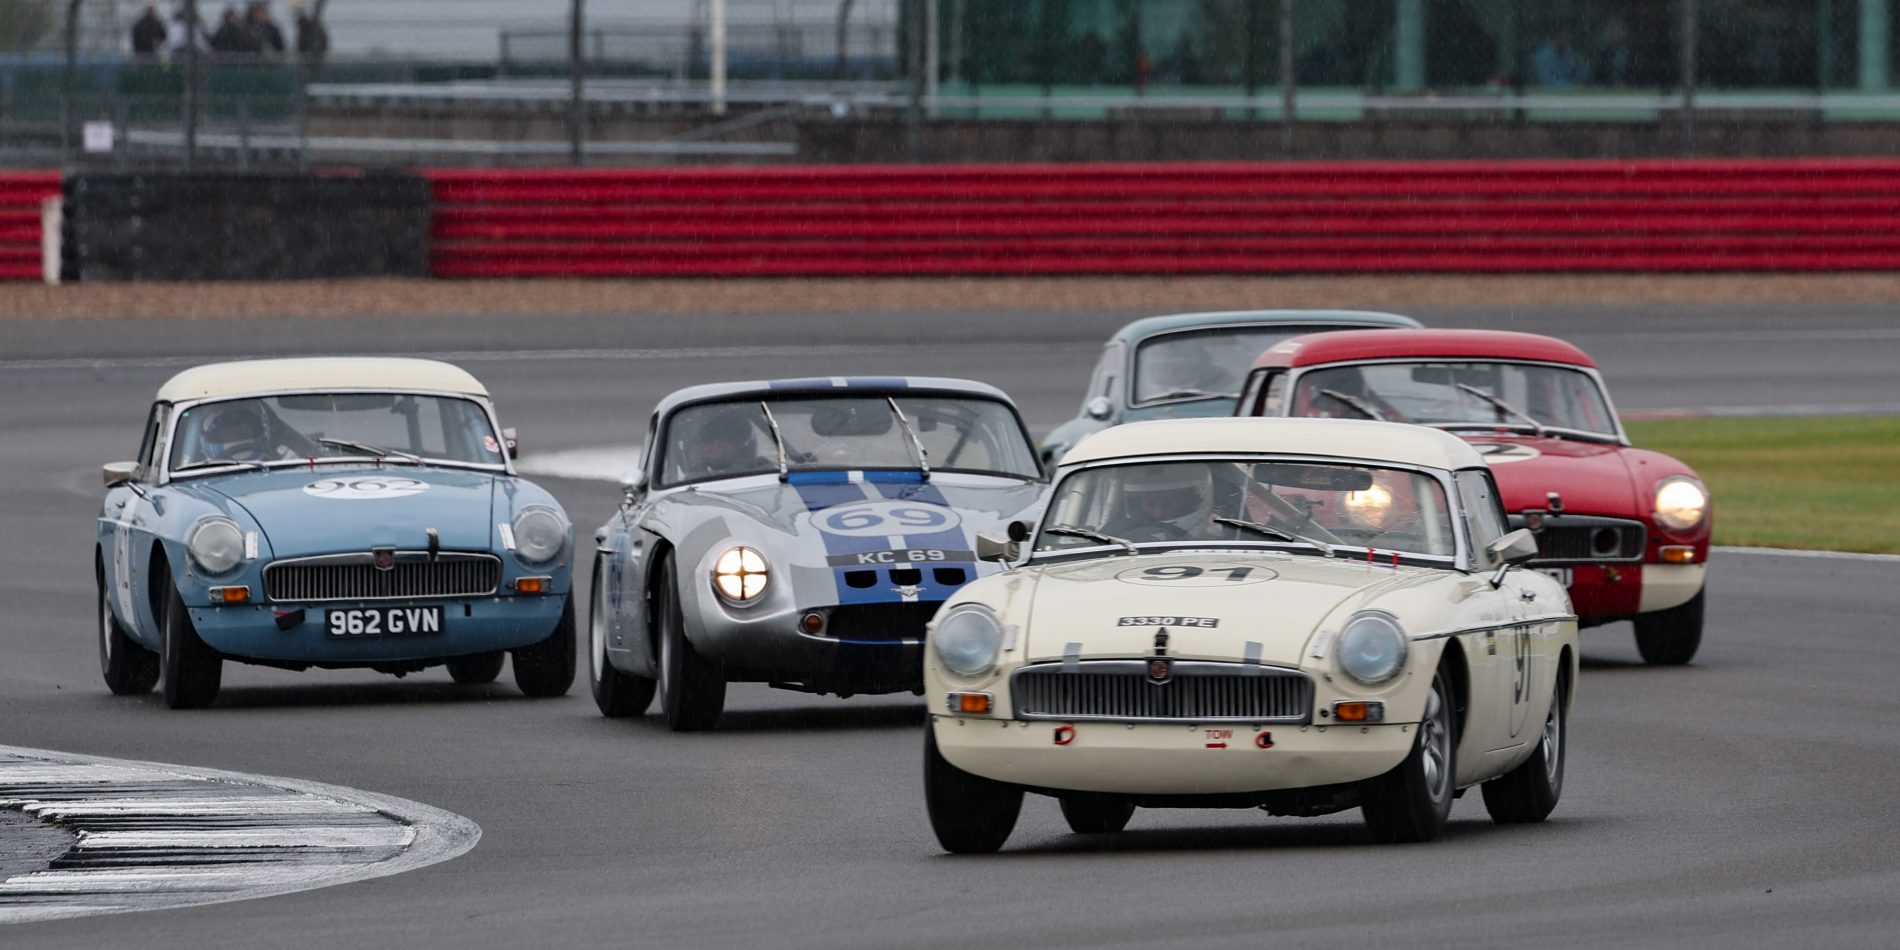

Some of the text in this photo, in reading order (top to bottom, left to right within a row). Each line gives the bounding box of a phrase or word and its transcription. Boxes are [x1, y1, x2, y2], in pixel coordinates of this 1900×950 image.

[307, 480, 426, 493] 962
[826, 507, 946, 530] 69
[857, 549, 945, 564] KC 69
[1140, 565, 1253, 582] 91
[330, 608, 439, 635] 962 GVN
[1120, 616, 1213, 627] 3330 PE
[1514, 616, 1531, 705] 91
[1205, 729, 1233, 739] TOW
